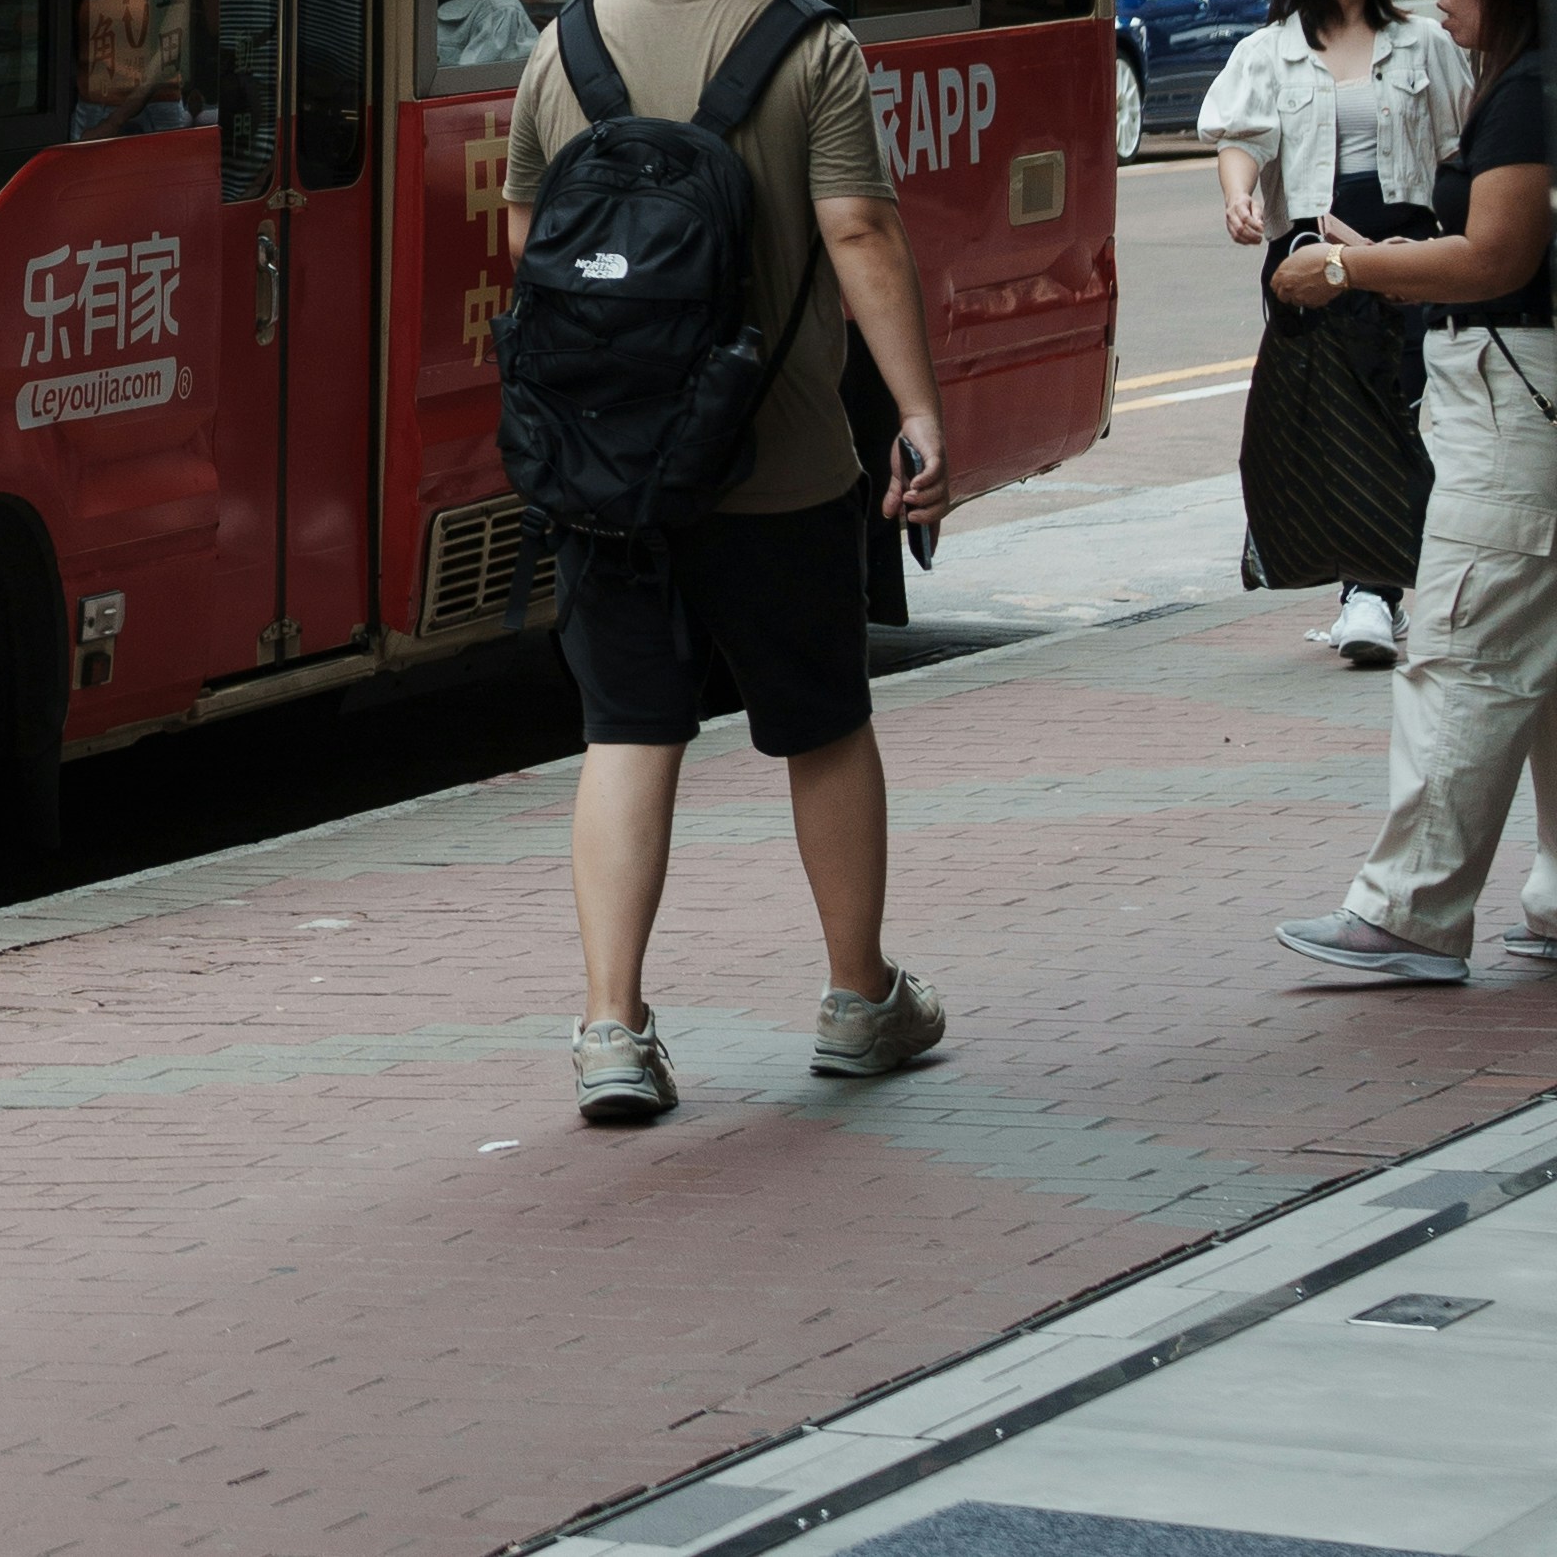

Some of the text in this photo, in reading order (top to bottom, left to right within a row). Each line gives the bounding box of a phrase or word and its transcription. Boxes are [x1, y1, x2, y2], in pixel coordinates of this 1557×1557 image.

[575, 258, 612, 271] NORTH
[595, 252, 614, 262] THE
[20, 230, 182, 368] 乐有家
[29, 365, 163, 423] Leyoujia.com
